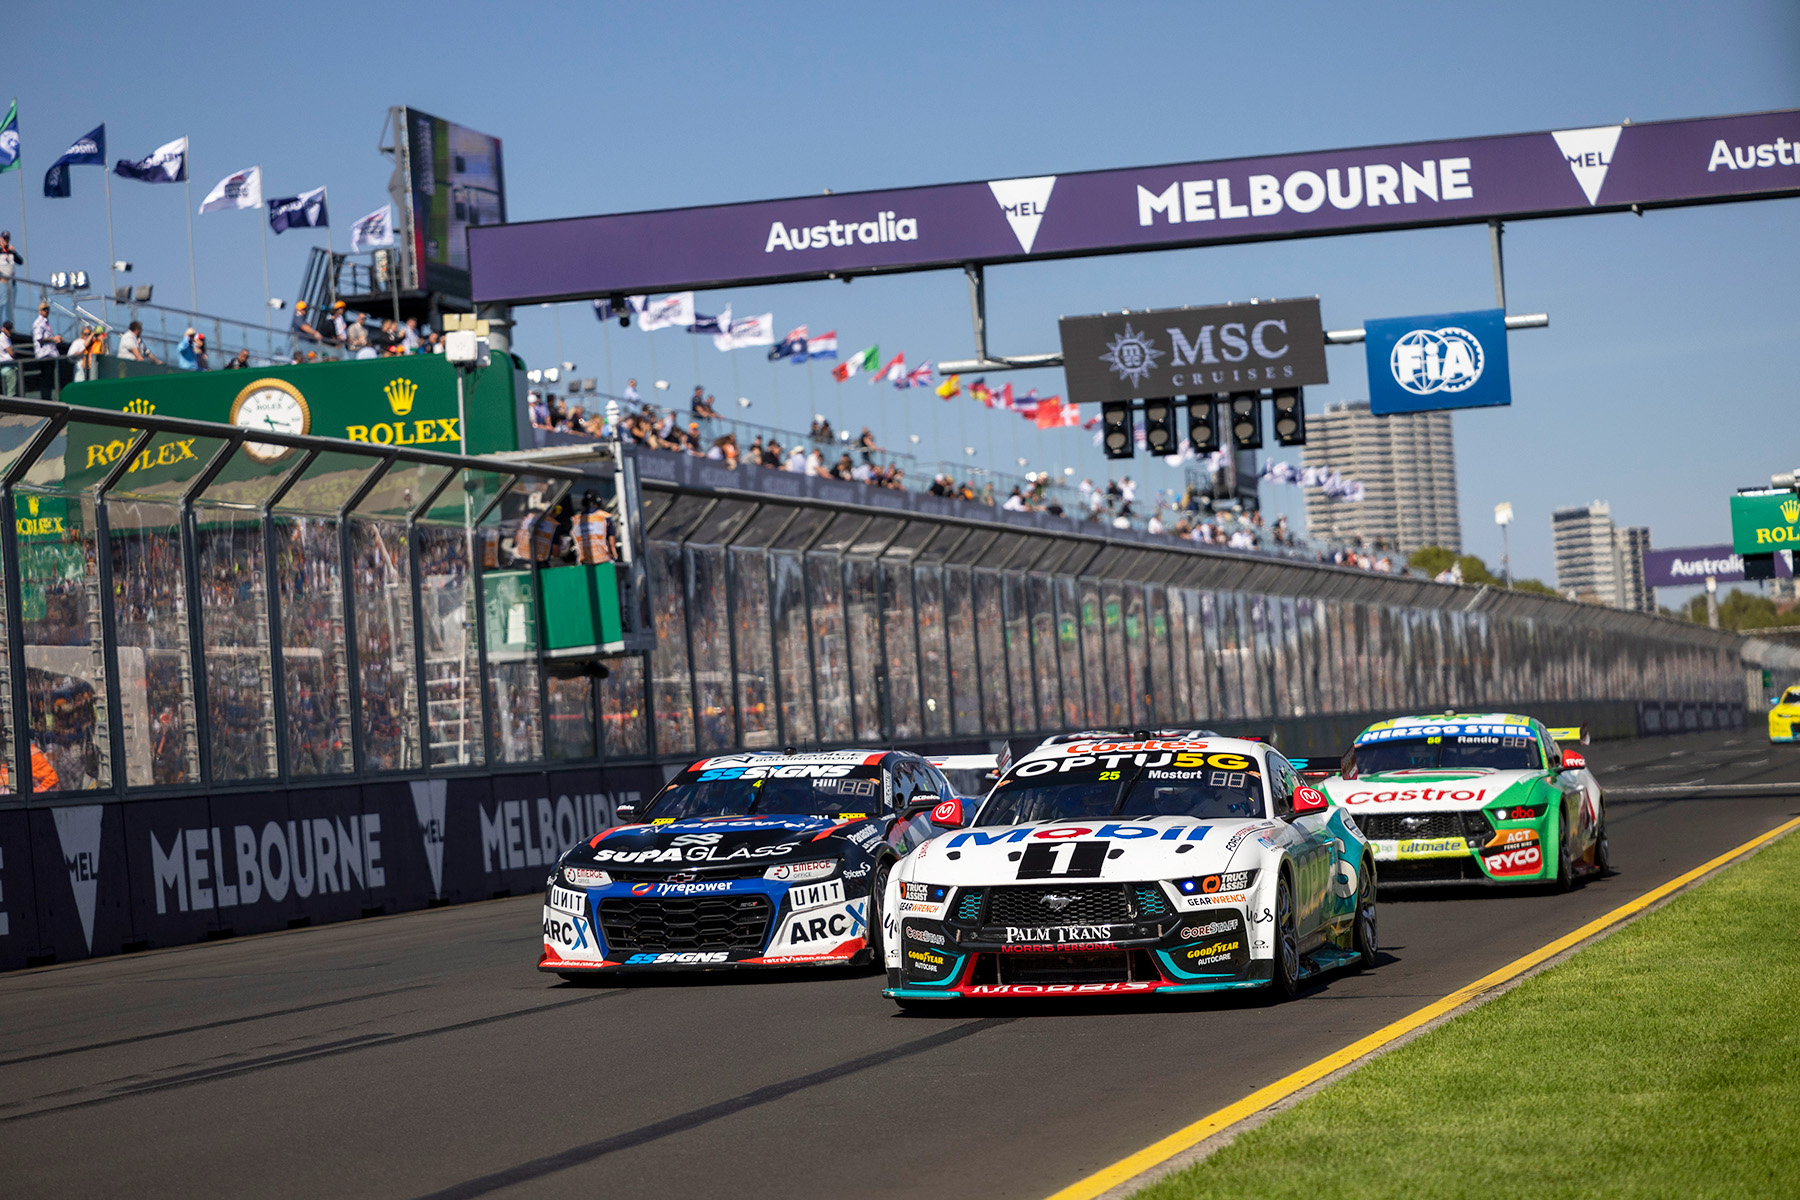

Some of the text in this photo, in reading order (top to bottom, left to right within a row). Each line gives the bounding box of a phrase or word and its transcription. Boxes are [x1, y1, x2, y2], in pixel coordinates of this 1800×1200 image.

[1566, 151, 1610, 168] MEL
[1137, 157, 1474, 227] MELBOURNE
[1002, 201, 1044, 217] MEL
[765, 211, 918, 253] Australia
[1165, 319, 1290, 367] MSC
[1172, 365, 1295, 387] CRUISES
[256, 402, 283, 411] ROLEX
[346, 418, 462, 446] ROLEX
[1756, 526, 1800, 544] ROL
[1361, 725, 1531, 742] HERZOG STEEL
[1457, 736, 1499, 744] Randle
[1066, 739, 1209, 754] Coates
[1098, 771, 1120, 781] 25
[1148, 769, 1203, 780] Mostert
[752, 779, 763, 788] 4
[812, 778, 837, 788] Hill
[1345, 787, 1487, 805] Castrol
[1511, 806, 1535, 820] dba
[420, 818, 445, 844] MEL
[946, 824, 1214, 848] Mobil
[1506, 829, 1531, 843] ACT
[150, 813, 386, 914] MELBOURNE
[1048, 842, 1078, 875] 1
[1485, 847, 1540, 871] RYCO
[64, 851, 98, 882] MEL
[577, 868, 603, 879] EMERGE
[792, 860, 832, 873] EMERGE
[843, 867, 868, 880] Spicers
[1220, 871, 1249, 883] TRUCK
[657, 880, 733, 896] Tyrepower
[905, 883, 928, 892] TRUCK
[1219, 880, 1248, 892] ASSIST
[905, 891, 928, 901] ASSIST
[1006, 926, 1111, 943] PALM TRANS
[1001, 942, 1118, 953] MORRIS PERSONAL
[1187, 941, 1239, 959] GOODYEAR
[908, 950, 944, 965] GOODYEAR
[1198, 953, 1232, 966] AUTOCARE
[914, 961, 938, 972] AUTOCARE
